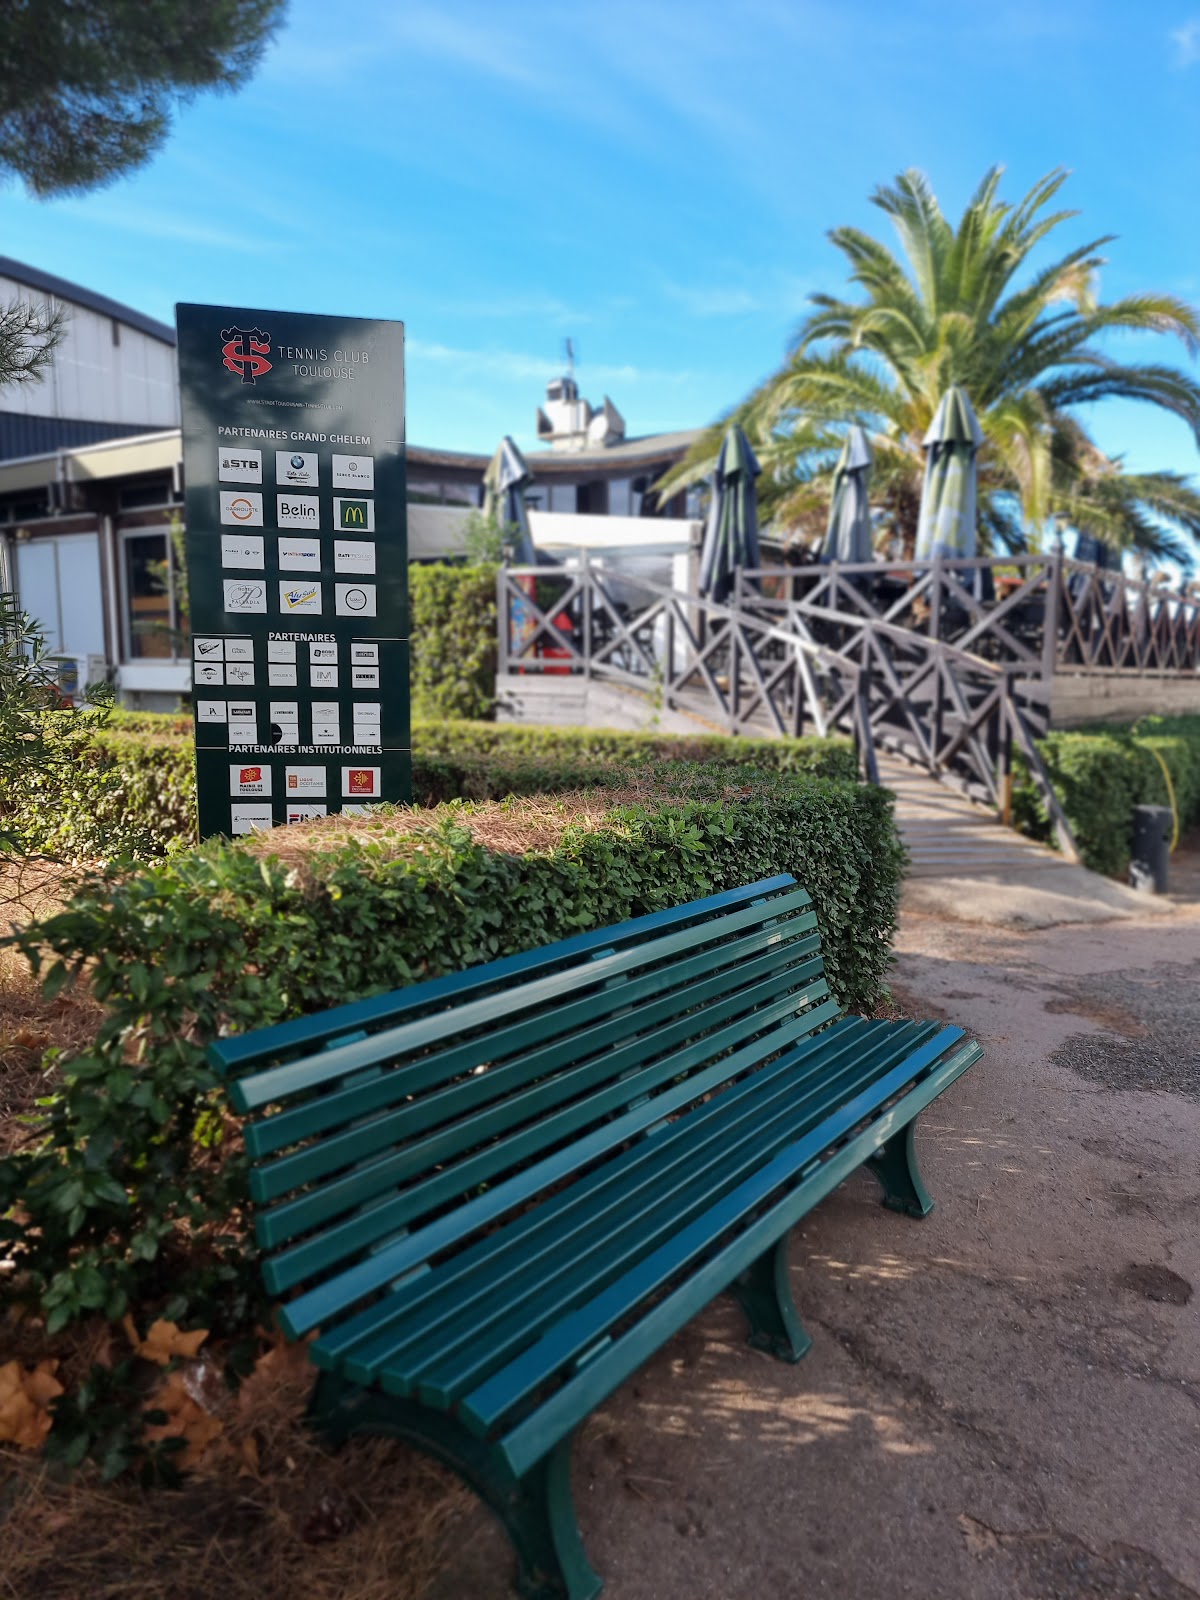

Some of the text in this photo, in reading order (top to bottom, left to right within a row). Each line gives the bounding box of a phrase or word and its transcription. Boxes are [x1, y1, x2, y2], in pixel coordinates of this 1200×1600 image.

[278, 346, 369, 364] TENNIS CLUB
[292, 365, 355, 379] TOULOUSE
[218, 426, 371, 445] PARTENAIRES GRAND CHELEM
[230, 460, 259, 469] STB
[281, 502, 316, 516] Belin
[268, 632, 336, 642] PARTENAIRES
[228, 745, 383, 755] PARTENAIRES INSTITUTIONNELS
